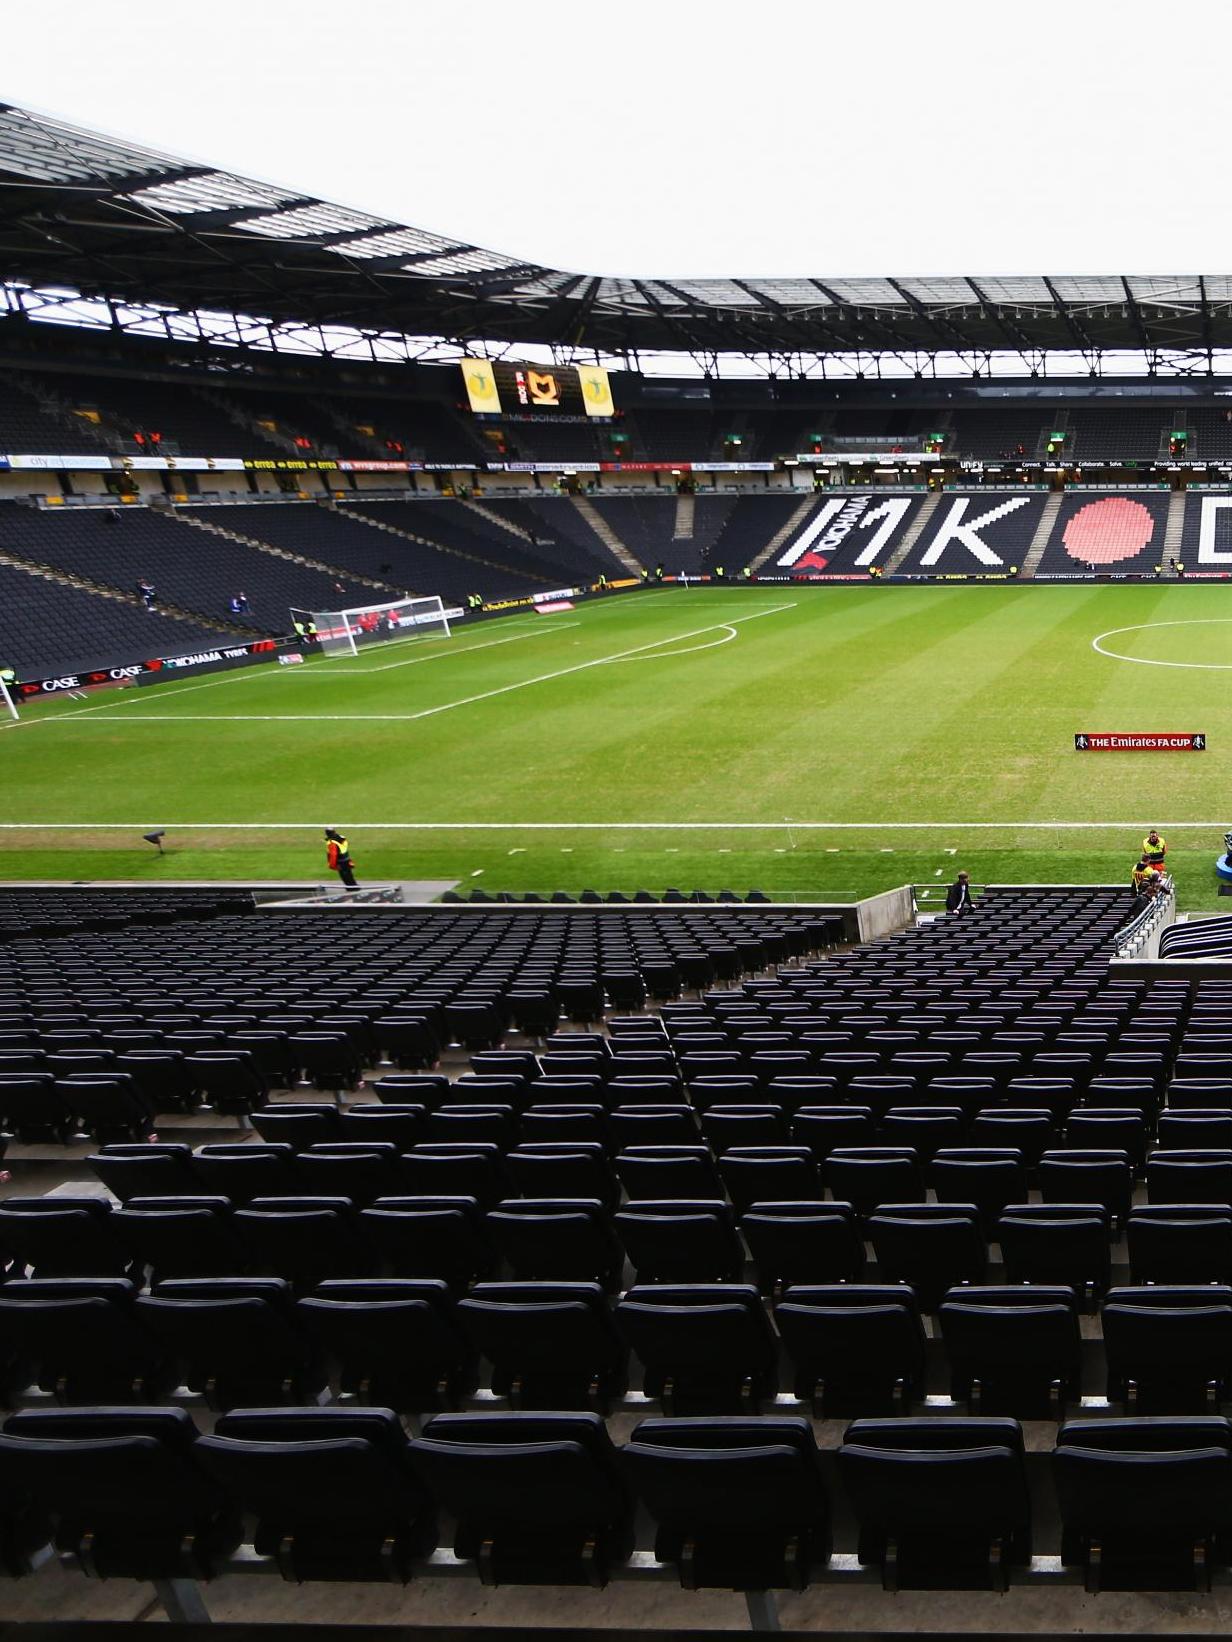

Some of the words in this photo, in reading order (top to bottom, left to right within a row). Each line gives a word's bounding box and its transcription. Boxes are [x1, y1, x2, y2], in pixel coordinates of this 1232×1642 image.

[812, 495, 873, 553] YOKOHAMA
[42, 676, 81, 691] CASE
[1090, 738, 1109, 747] THE
[1111, 736, 1156, 747] Emirates
[1157, 738, 1170, 747] FA
[1170, 738, 1191, 747] CUP
